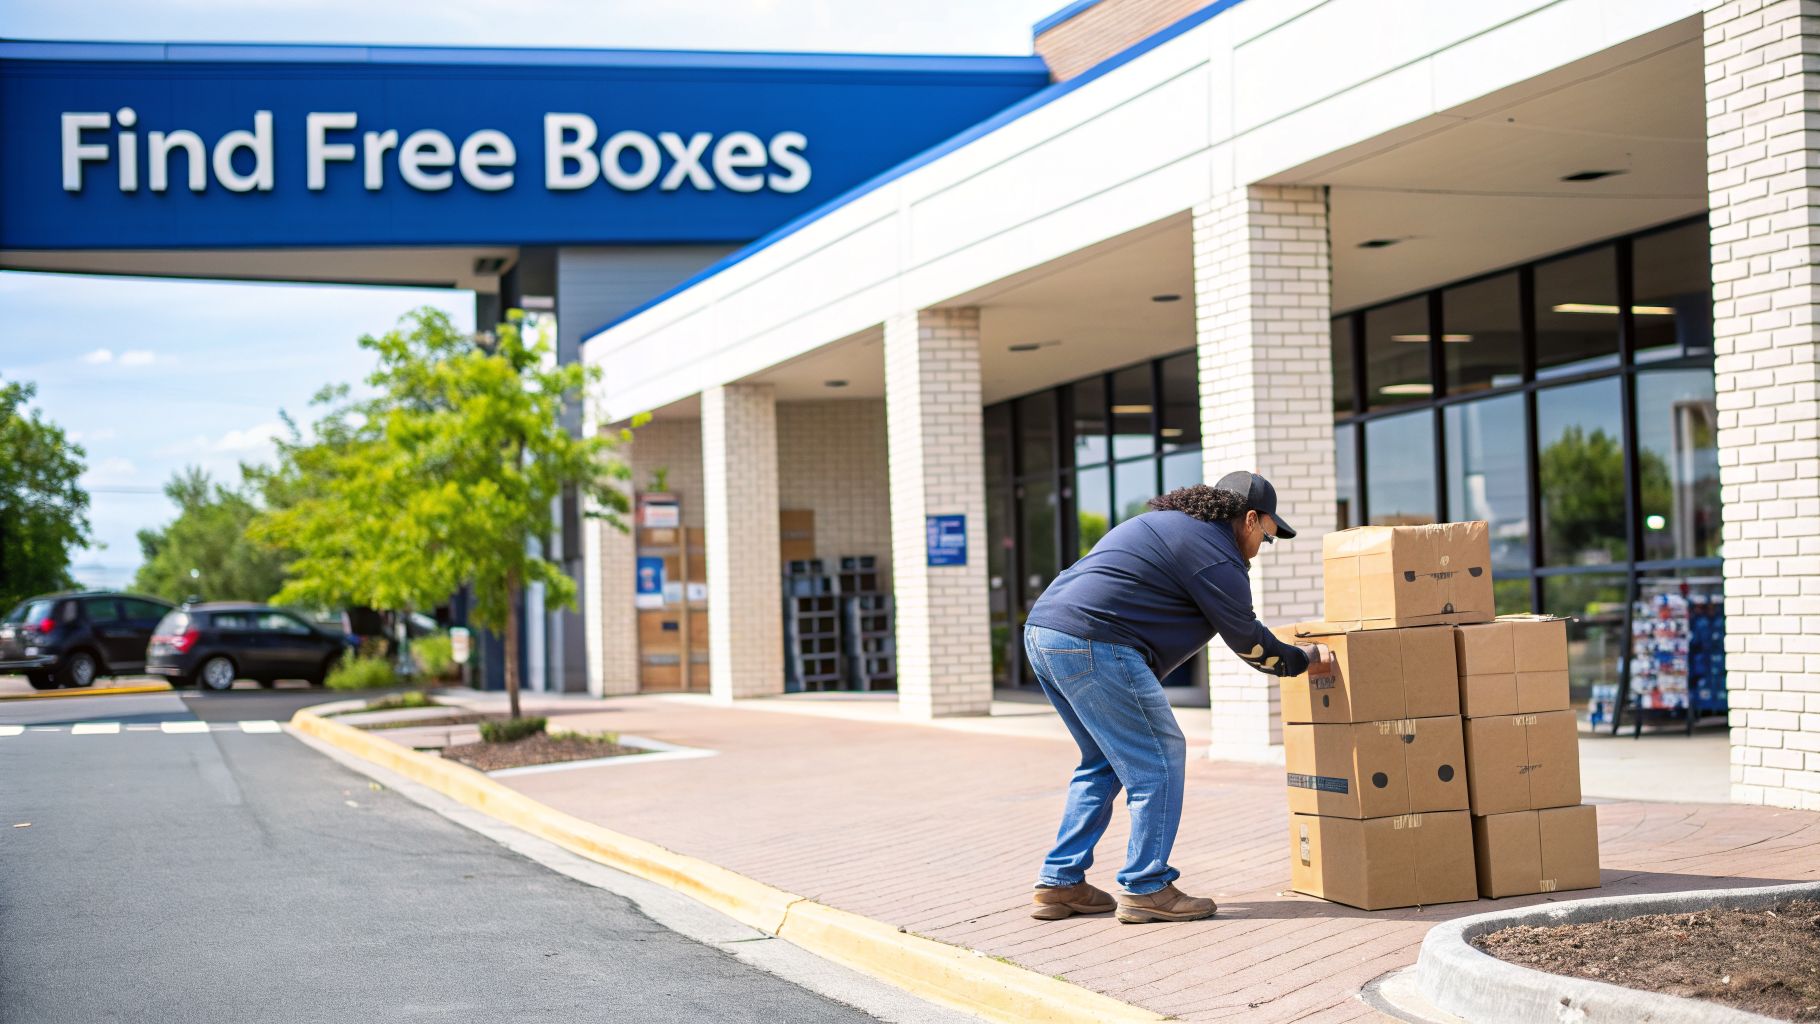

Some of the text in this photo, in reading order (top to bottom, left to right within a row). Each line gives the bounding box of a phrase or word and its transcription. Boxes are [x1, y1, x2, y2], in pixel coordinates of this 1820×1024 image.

[60, 107, 811, 193] Find Free Boxes
